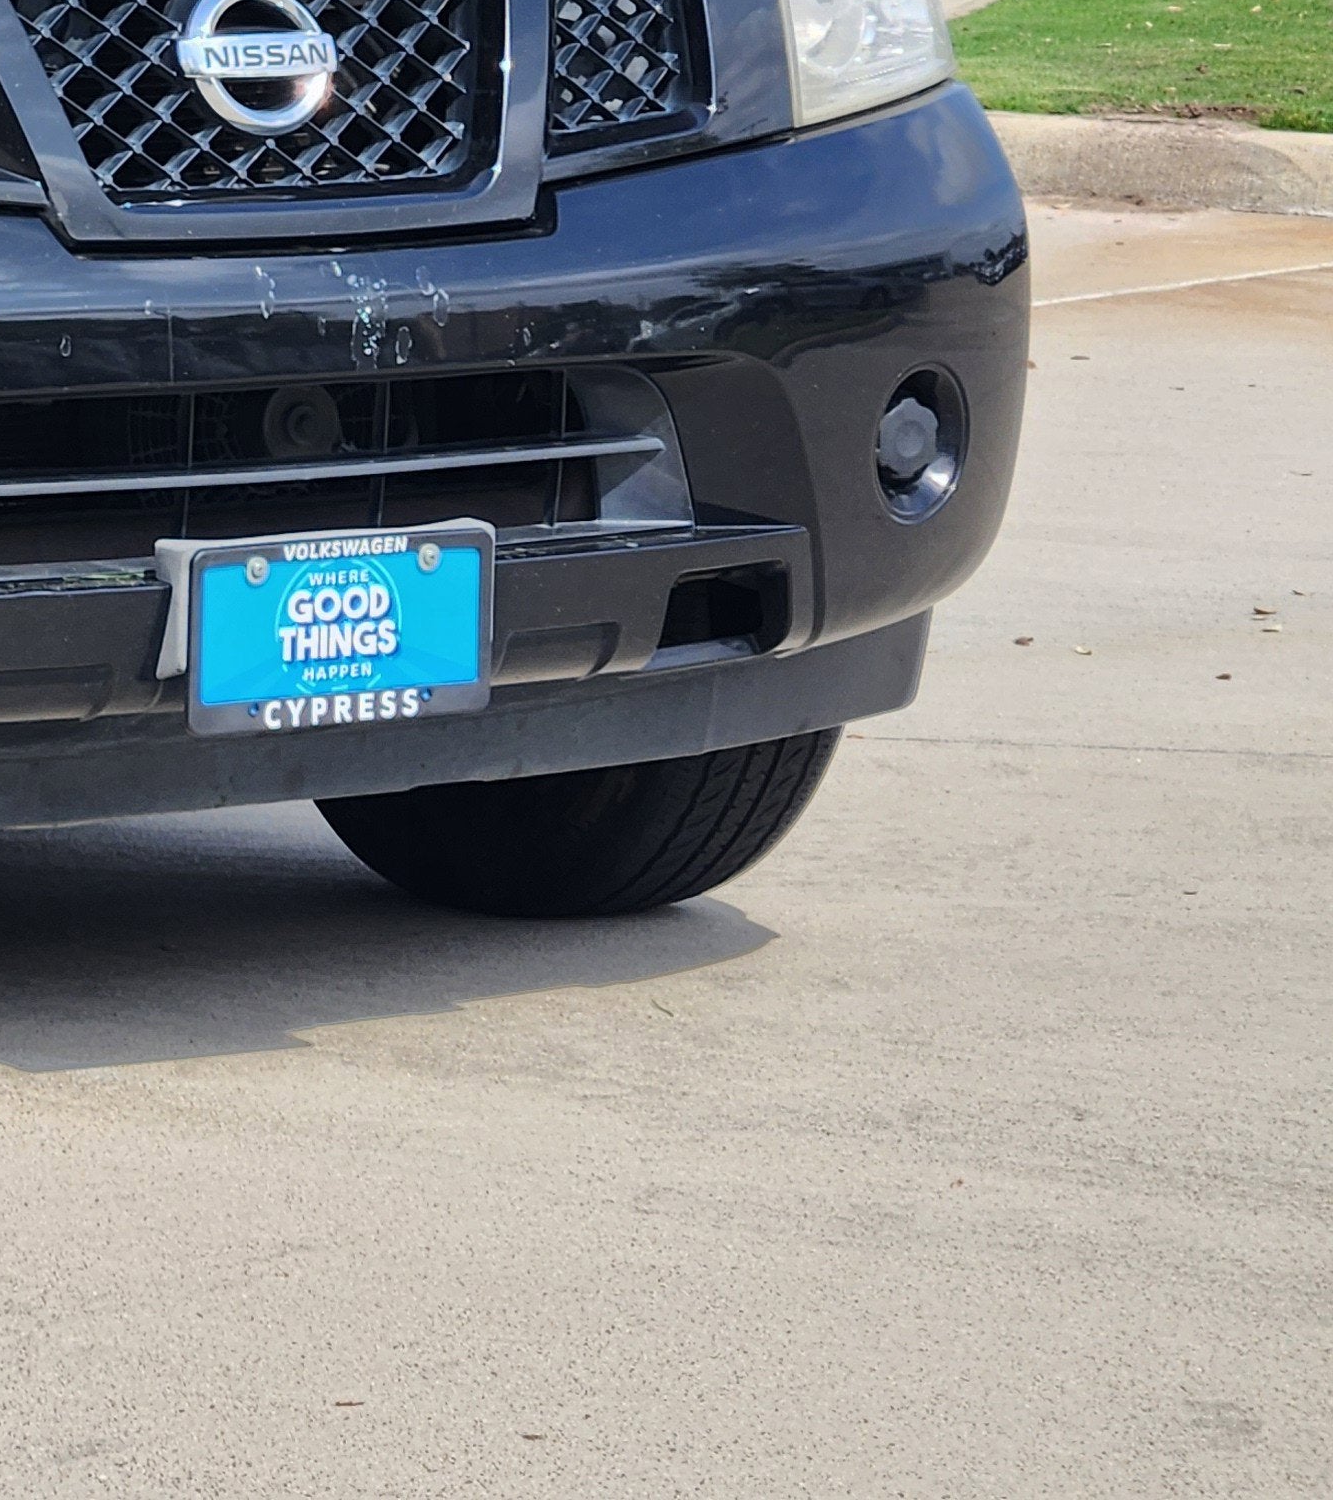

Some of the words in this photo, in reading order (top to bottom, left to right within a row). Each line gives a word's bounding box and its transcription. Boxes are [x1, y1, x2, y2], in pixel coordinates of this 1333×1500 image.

[203, 42, 329, 69] NISSAN
[283, 535, 408, 562] VOLKSWAGEN
[309, 568, 371, 587] WHERE
[287, 584, 390, 624] GOOD
[278, 619, 398, 662] THINGS
[302, 662, 373, 682] HAPPEN
[263, 688, 420, 731] CYPRESS
